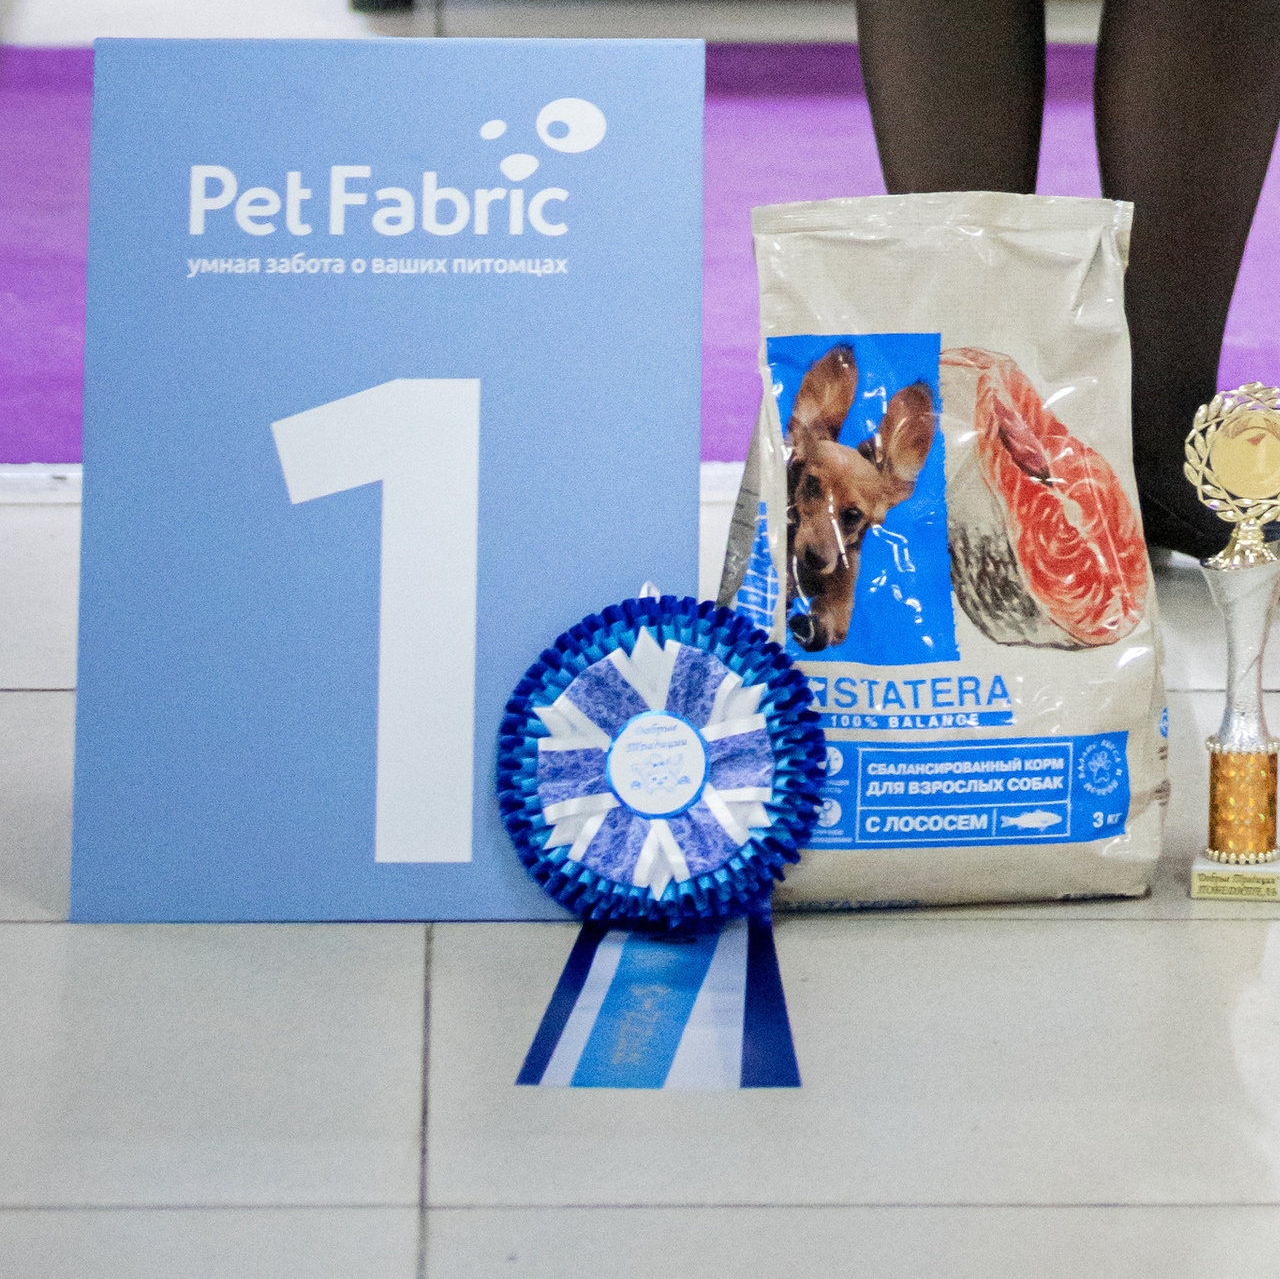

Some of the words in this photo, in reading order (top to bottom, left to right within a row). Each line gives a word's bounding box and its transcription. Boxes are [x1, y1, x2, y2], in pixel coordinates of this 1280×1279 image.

[188, 164, 312, 236] Pet
[329, 162, 570, 236] Fabric
[186, 257, 261, 278] умная
[265, 252, 346, 274] забота
[351, 258, 367, 274] о
[371, 258, 447, 274] ваших
[452, 258, 568, 277] питомцах
[270, 378, 481, 863] 1
[830, 714, 878, 729] 100%
[888, 713, 980, 729] BALANCE
[867, 757, 1023, 776] СБАЛАНСИРОВАННЫЙ
[1024, 757, 1065, 772] КОРМ
[866, 781, 905, 798] ДЛЯ
[908, 778, 1005, 795] ВЗРОСЛЫХ
[1007, 775, 1065, 792] СОБАК
[865, 815, 881, 833] С
[883, 813, 989, 832] ЛОСОСЕМ
[1092, 811, 1105, 828] 3
